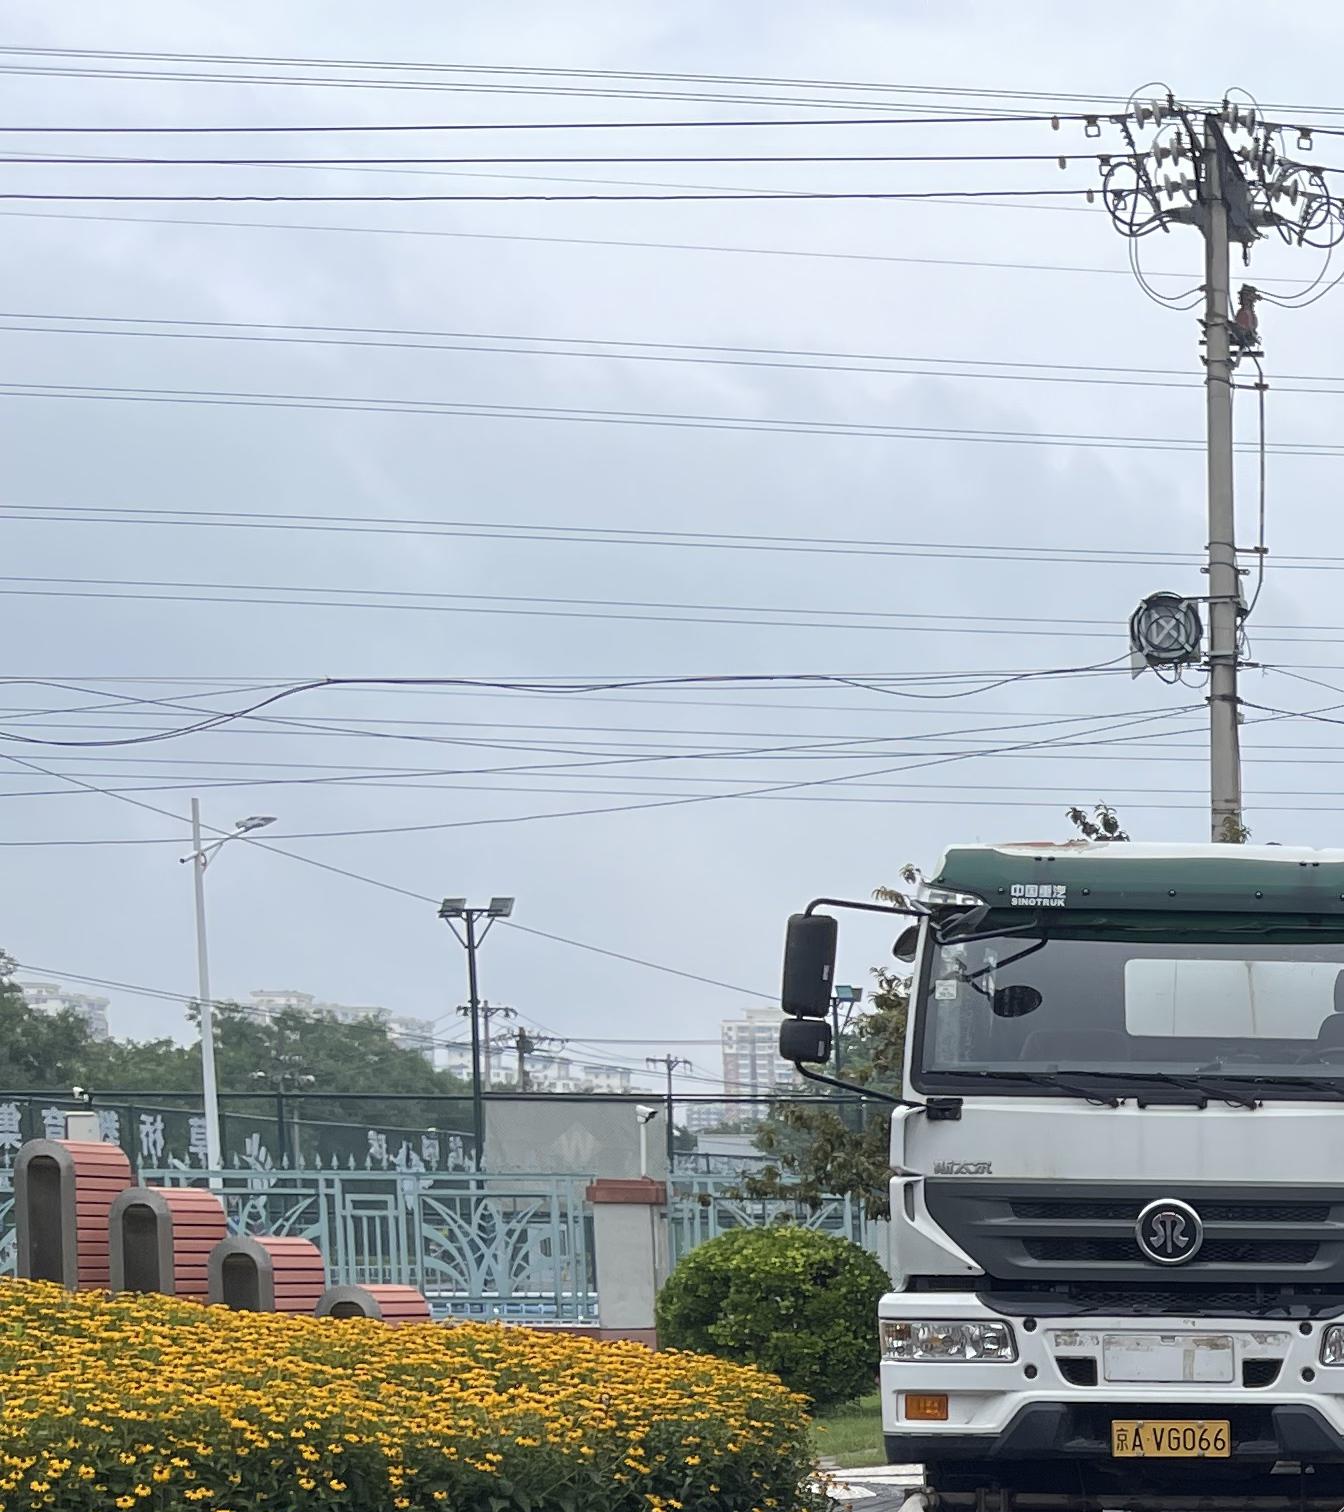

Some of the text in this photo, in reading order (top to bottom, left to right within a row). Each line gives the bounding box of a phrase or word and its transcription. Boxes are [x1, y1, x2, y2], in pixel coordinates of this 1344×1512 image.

[1011, 884, 1066, 898] 中国重汽
[1011, 897, 1065, 907] SINOTRUK
